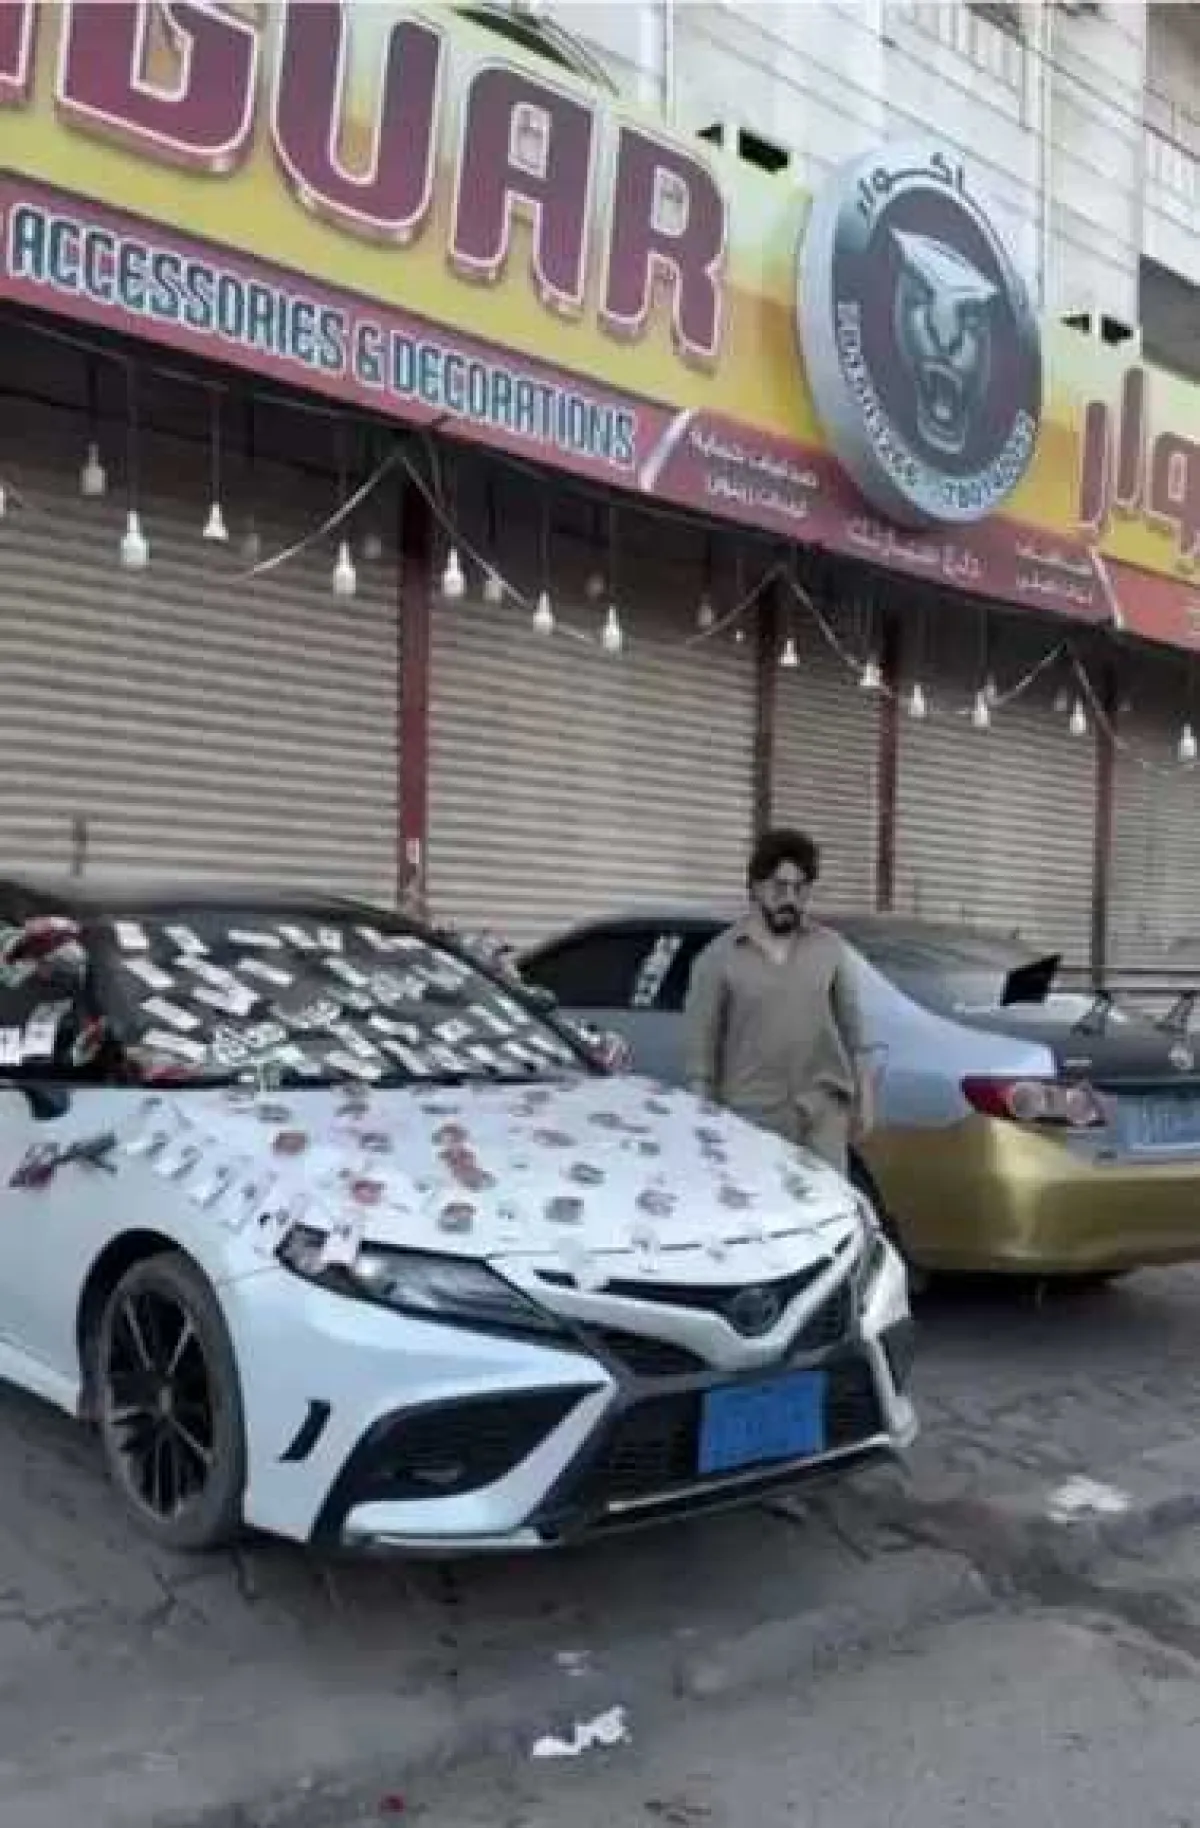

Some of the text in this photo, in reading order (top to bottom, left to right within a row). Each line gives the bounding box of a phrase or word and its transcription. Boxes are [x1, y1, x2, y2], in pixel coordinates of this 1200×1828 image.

[0, 0, 727, 362] GUAR
[9, 202, 348, 380] ACCESSORIES
[352, 318, 386, 390] &
[390, 329, 638, 471] DECORATIONS
